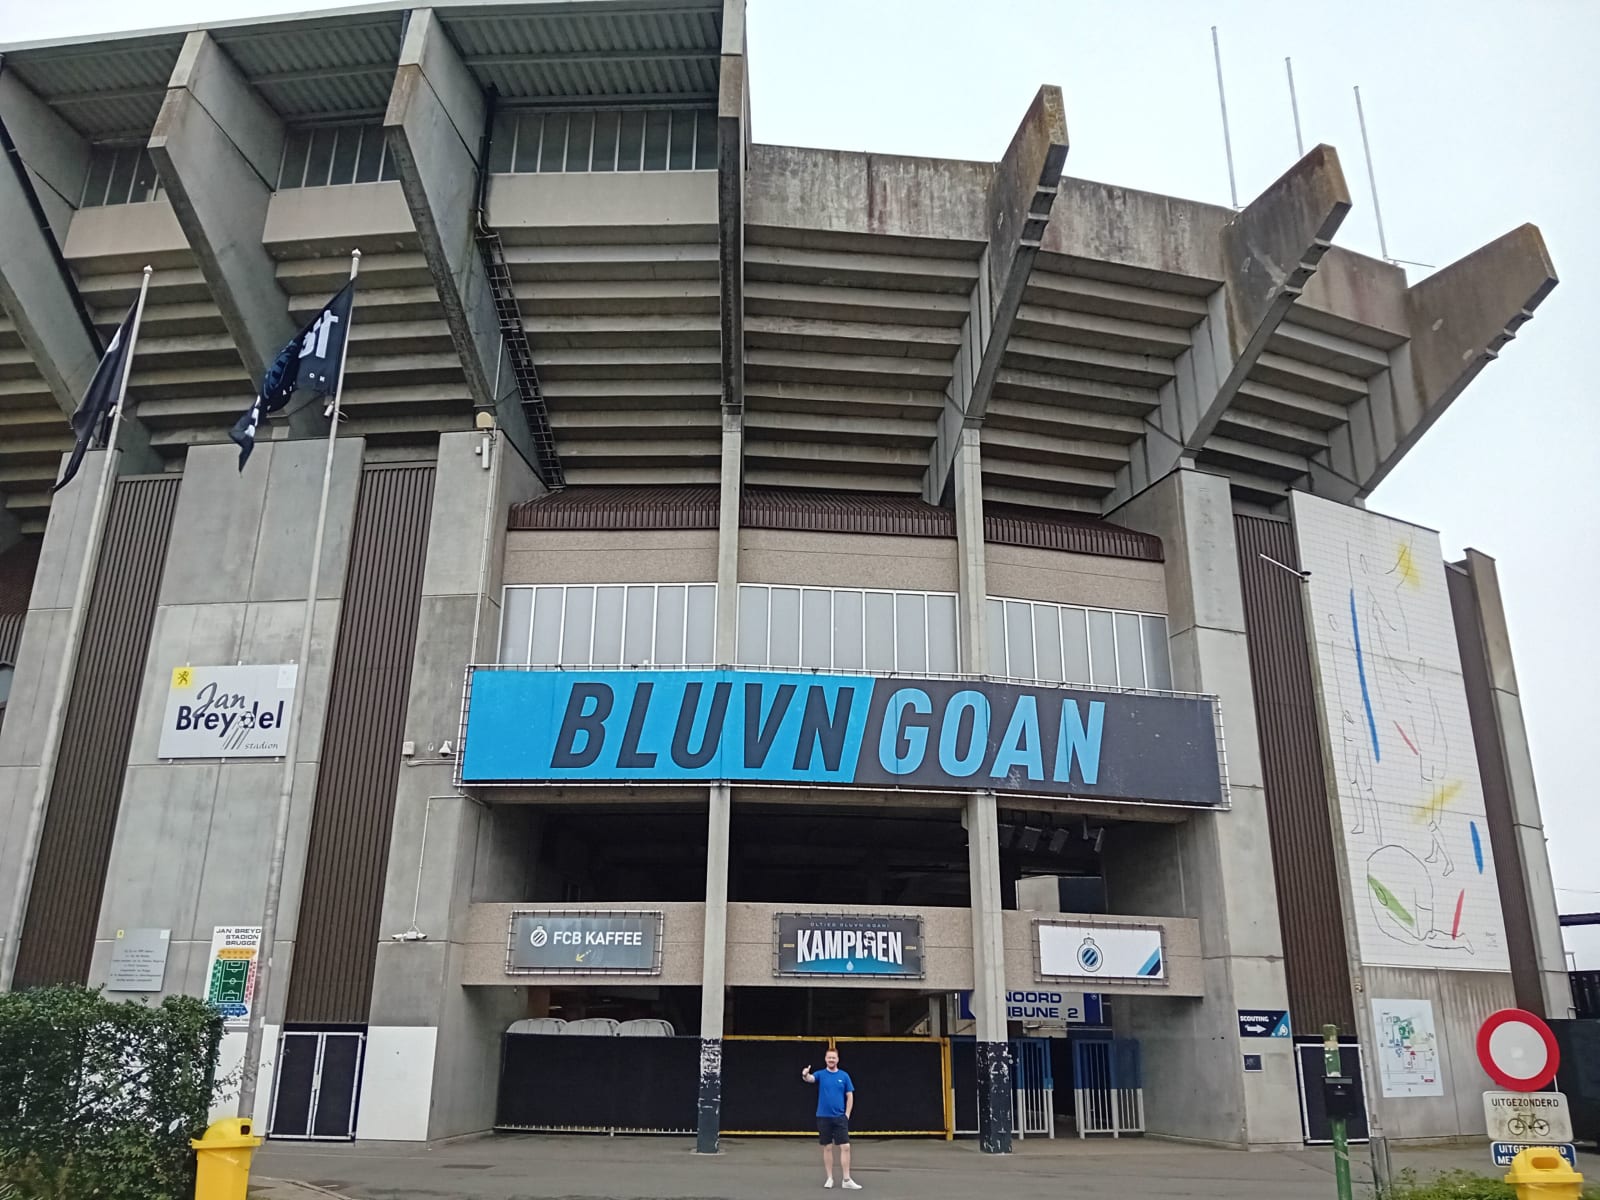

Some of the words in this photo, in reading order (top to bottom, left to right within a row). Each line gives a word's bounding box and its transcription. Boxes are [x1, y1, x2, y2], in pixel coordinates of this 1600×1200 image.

[192, 681, 246, 718] Jan
[176, 700, 285, 738] Breydel
[550, 683, 855, 771] BLUVN
[878, 688, 1106, 785] GOAN
[244, 740, 279, 750] stadion
[553, 931, 582, 945] FCB
[585, 931, 643, 946] KAFFEE
[1007, 1006, 1059, 1018] IBUNE
[1067, 1007, 1079, 1019] 2
[1491, 1098, 1559, 1108] UITGEZONDERD
